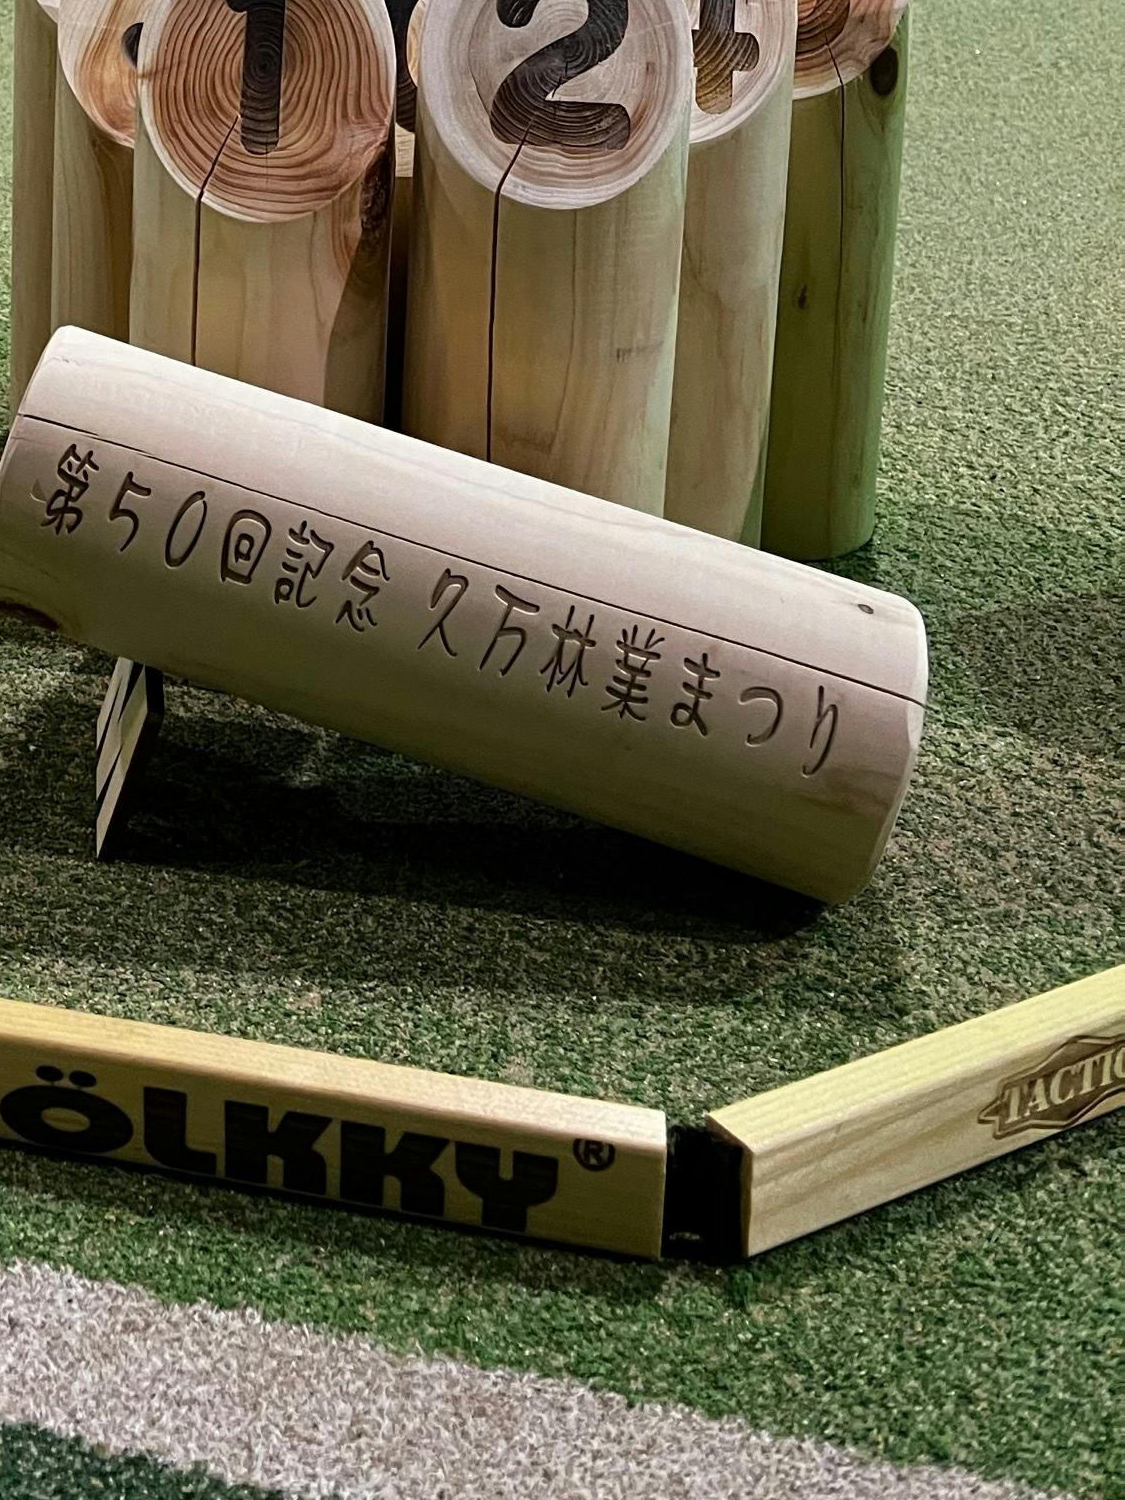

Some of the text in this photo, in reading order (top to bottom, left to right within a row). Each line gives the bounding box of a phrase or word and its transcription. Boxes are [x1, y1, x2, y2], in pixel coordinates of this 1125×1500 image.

[40, 443, 839, 778] 第50回記念 久万林業まつり
